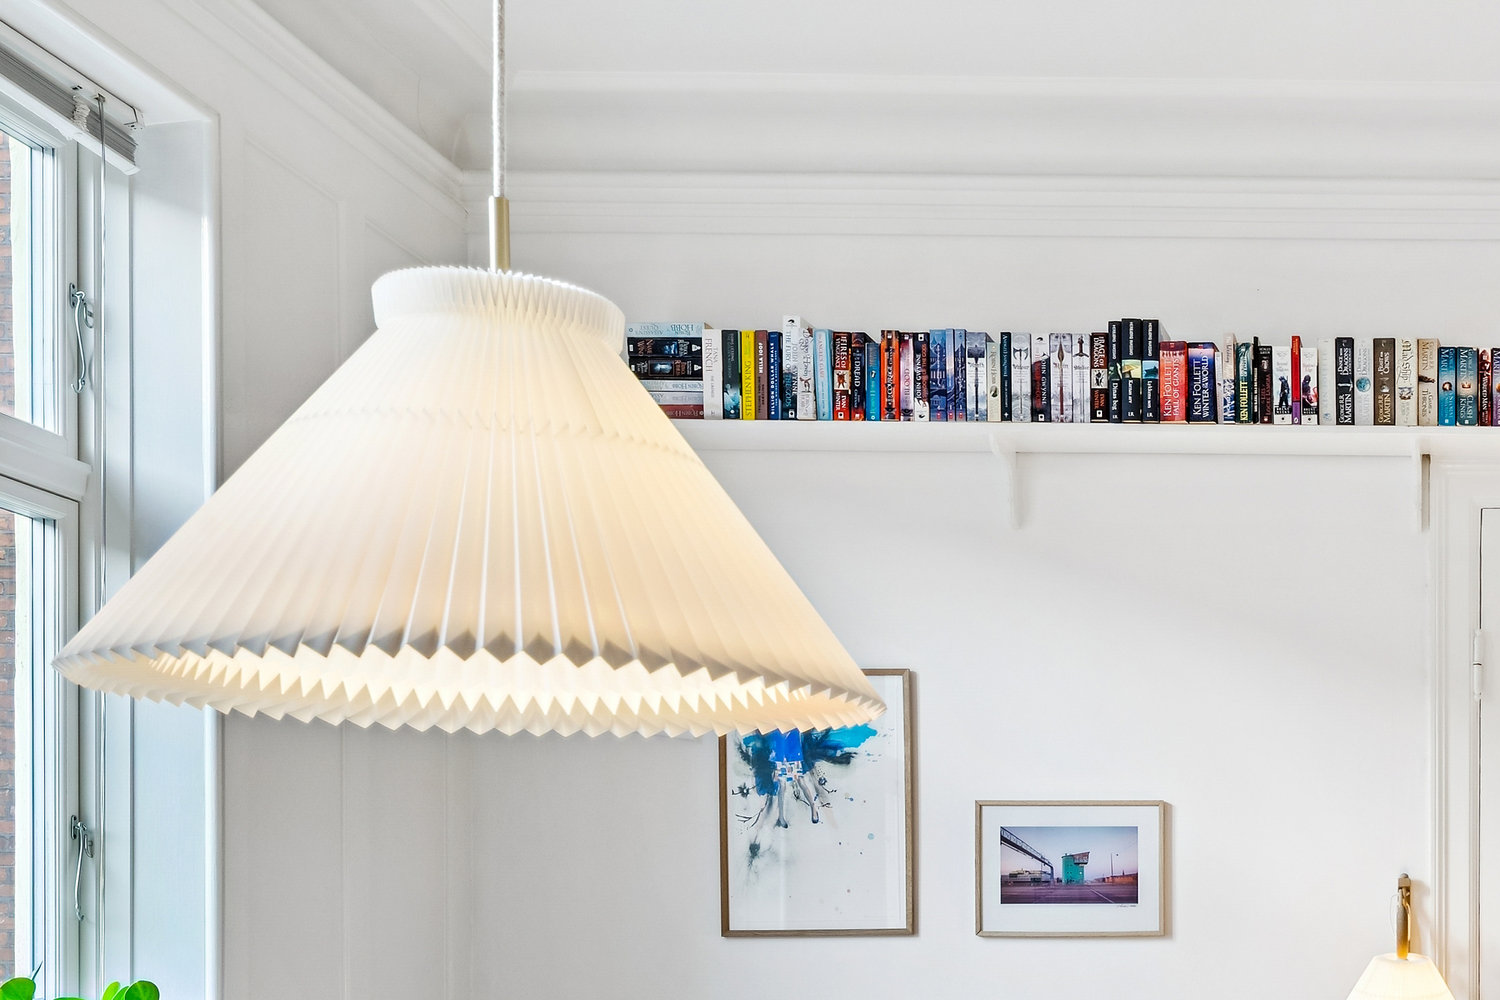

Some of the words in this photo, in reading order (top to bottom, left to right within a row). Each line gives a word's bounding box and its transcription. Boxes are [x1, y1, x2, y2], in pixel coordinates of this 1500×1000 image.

[705, 338, 713, 372] FRENCH
[1460, 349, 1468, 381] MARTIN
[1164, 360, 1172, 397] FOLLETT
[1193, 359, 1201, 396] FOLLETT
[1172, 388, 1180, 398] OF
[1240, 381, 1248, 407] FOLLETT
[1164, 399, 1172, 416] KEN
[1193, 398, 1201, 415] KEN
[1240, 408, 1248, 421] KEN
